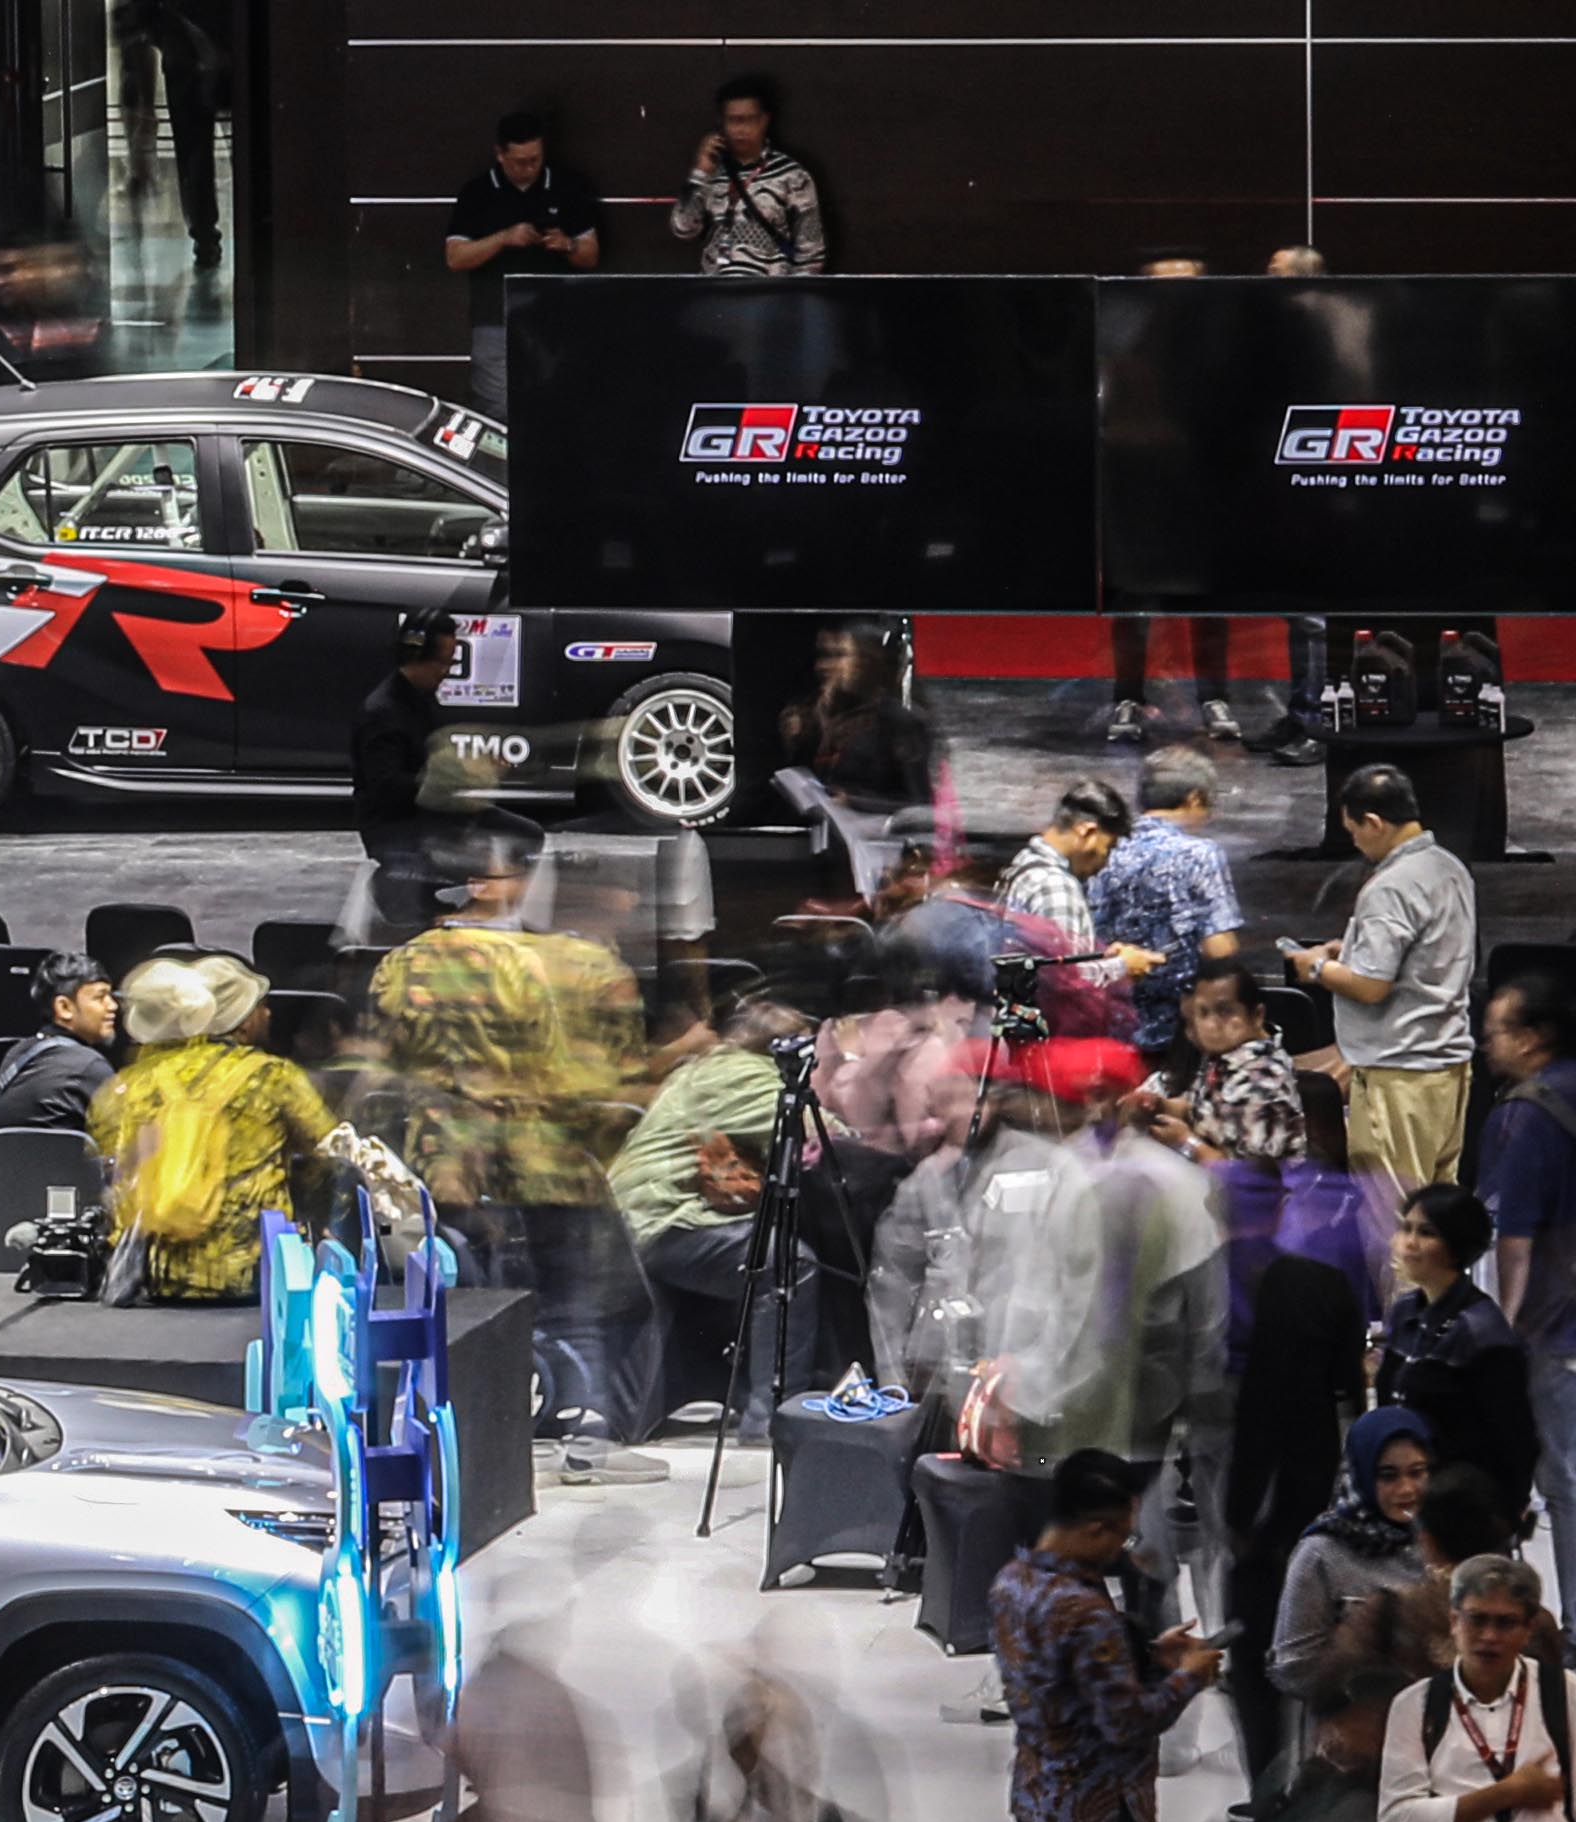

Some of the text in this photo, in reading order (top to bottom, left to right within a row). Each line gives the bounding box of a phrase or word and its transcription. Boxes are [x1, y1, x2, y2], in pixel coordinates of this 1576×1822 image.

[802, 406, 920, 424] TOYOTA
[1400, 407, 1520, 425] TOYOTA
[687, 426, 787, 458] GR
[797, 426, 907, 442] GAZOO
[1395, 427, 1507, 443] GAZOO
[795, 443, 902, 465] Racing
[1283, 429, 1384, 460] GR
[1392, 444, 1502, 466] Racing
[695, 472, 906, 485] Pushing the limits for Better
[1291, 474, 1506, 487] Pushing the limits for Better
[78, 728, 157, 749] TCD
[450, 734, 530, 764] TMO
